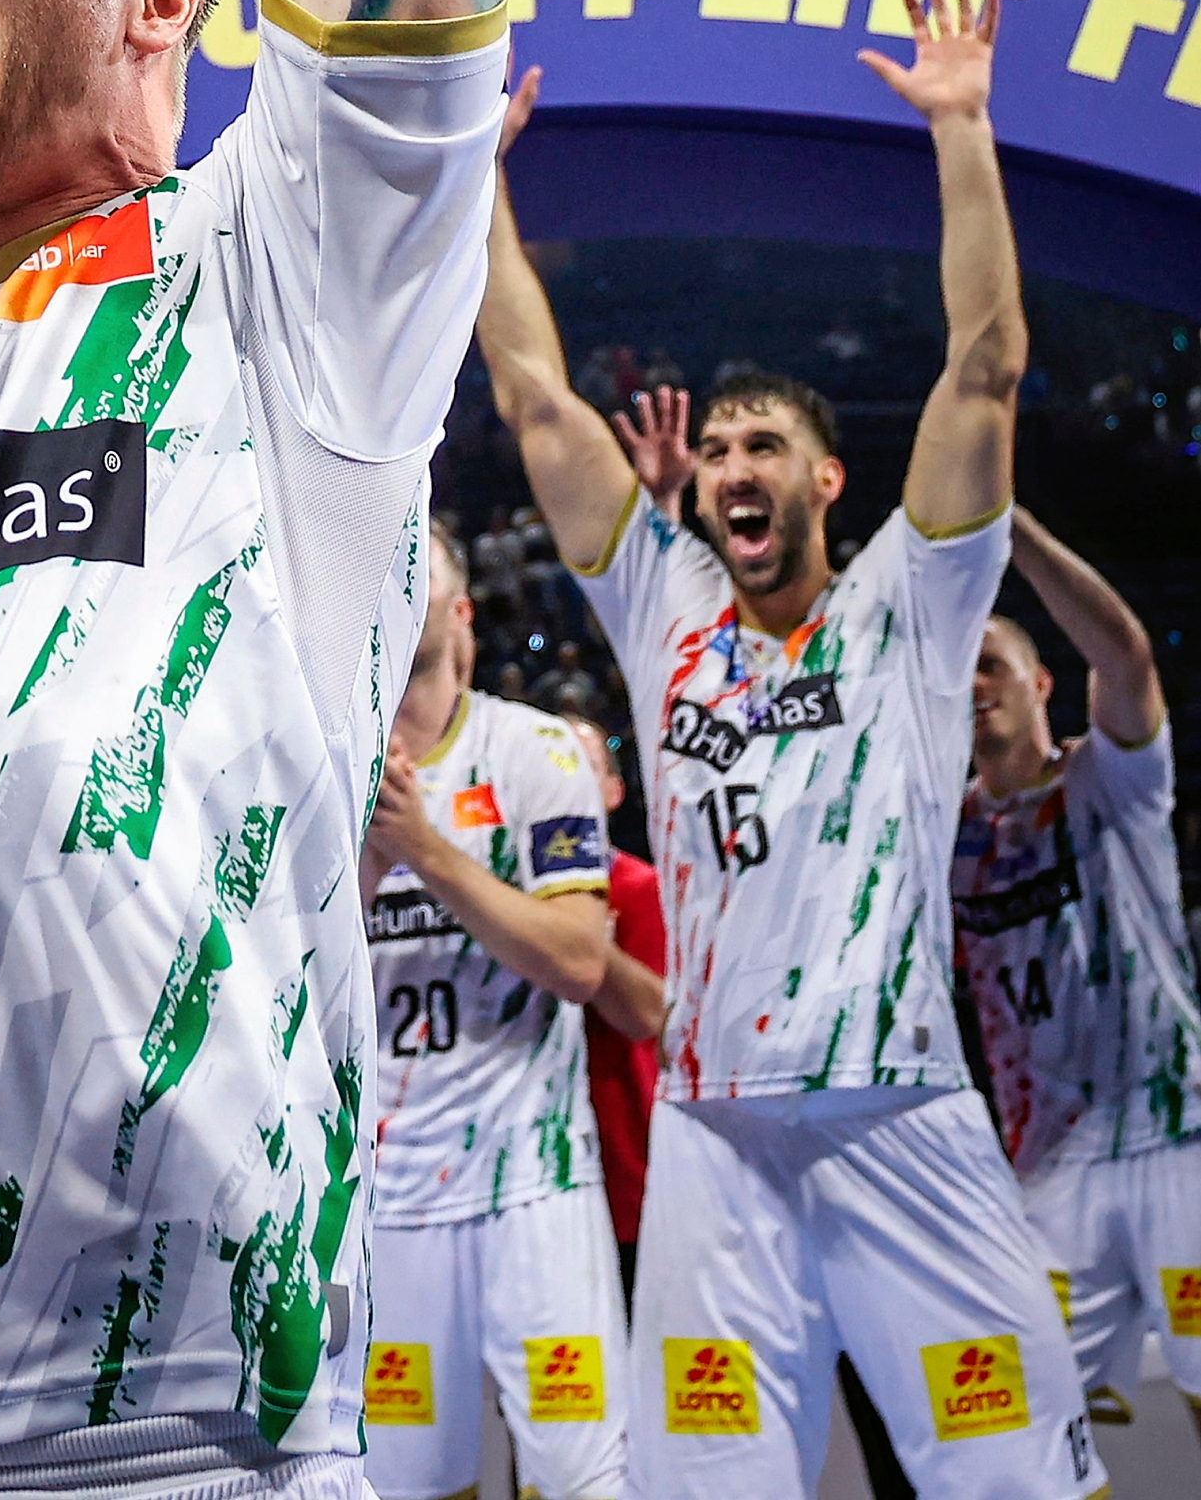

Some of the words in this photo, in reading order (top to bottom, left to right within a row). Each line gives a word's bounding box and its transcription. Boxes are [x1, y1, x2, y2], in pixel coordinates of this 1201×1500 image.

[697, 783, 769, 873] 15
[388, 979, 458, 1059] 20
[675, 1391, 745, 1412] LOTTO
[944, 1388, 1013, 1417] LOTTO
